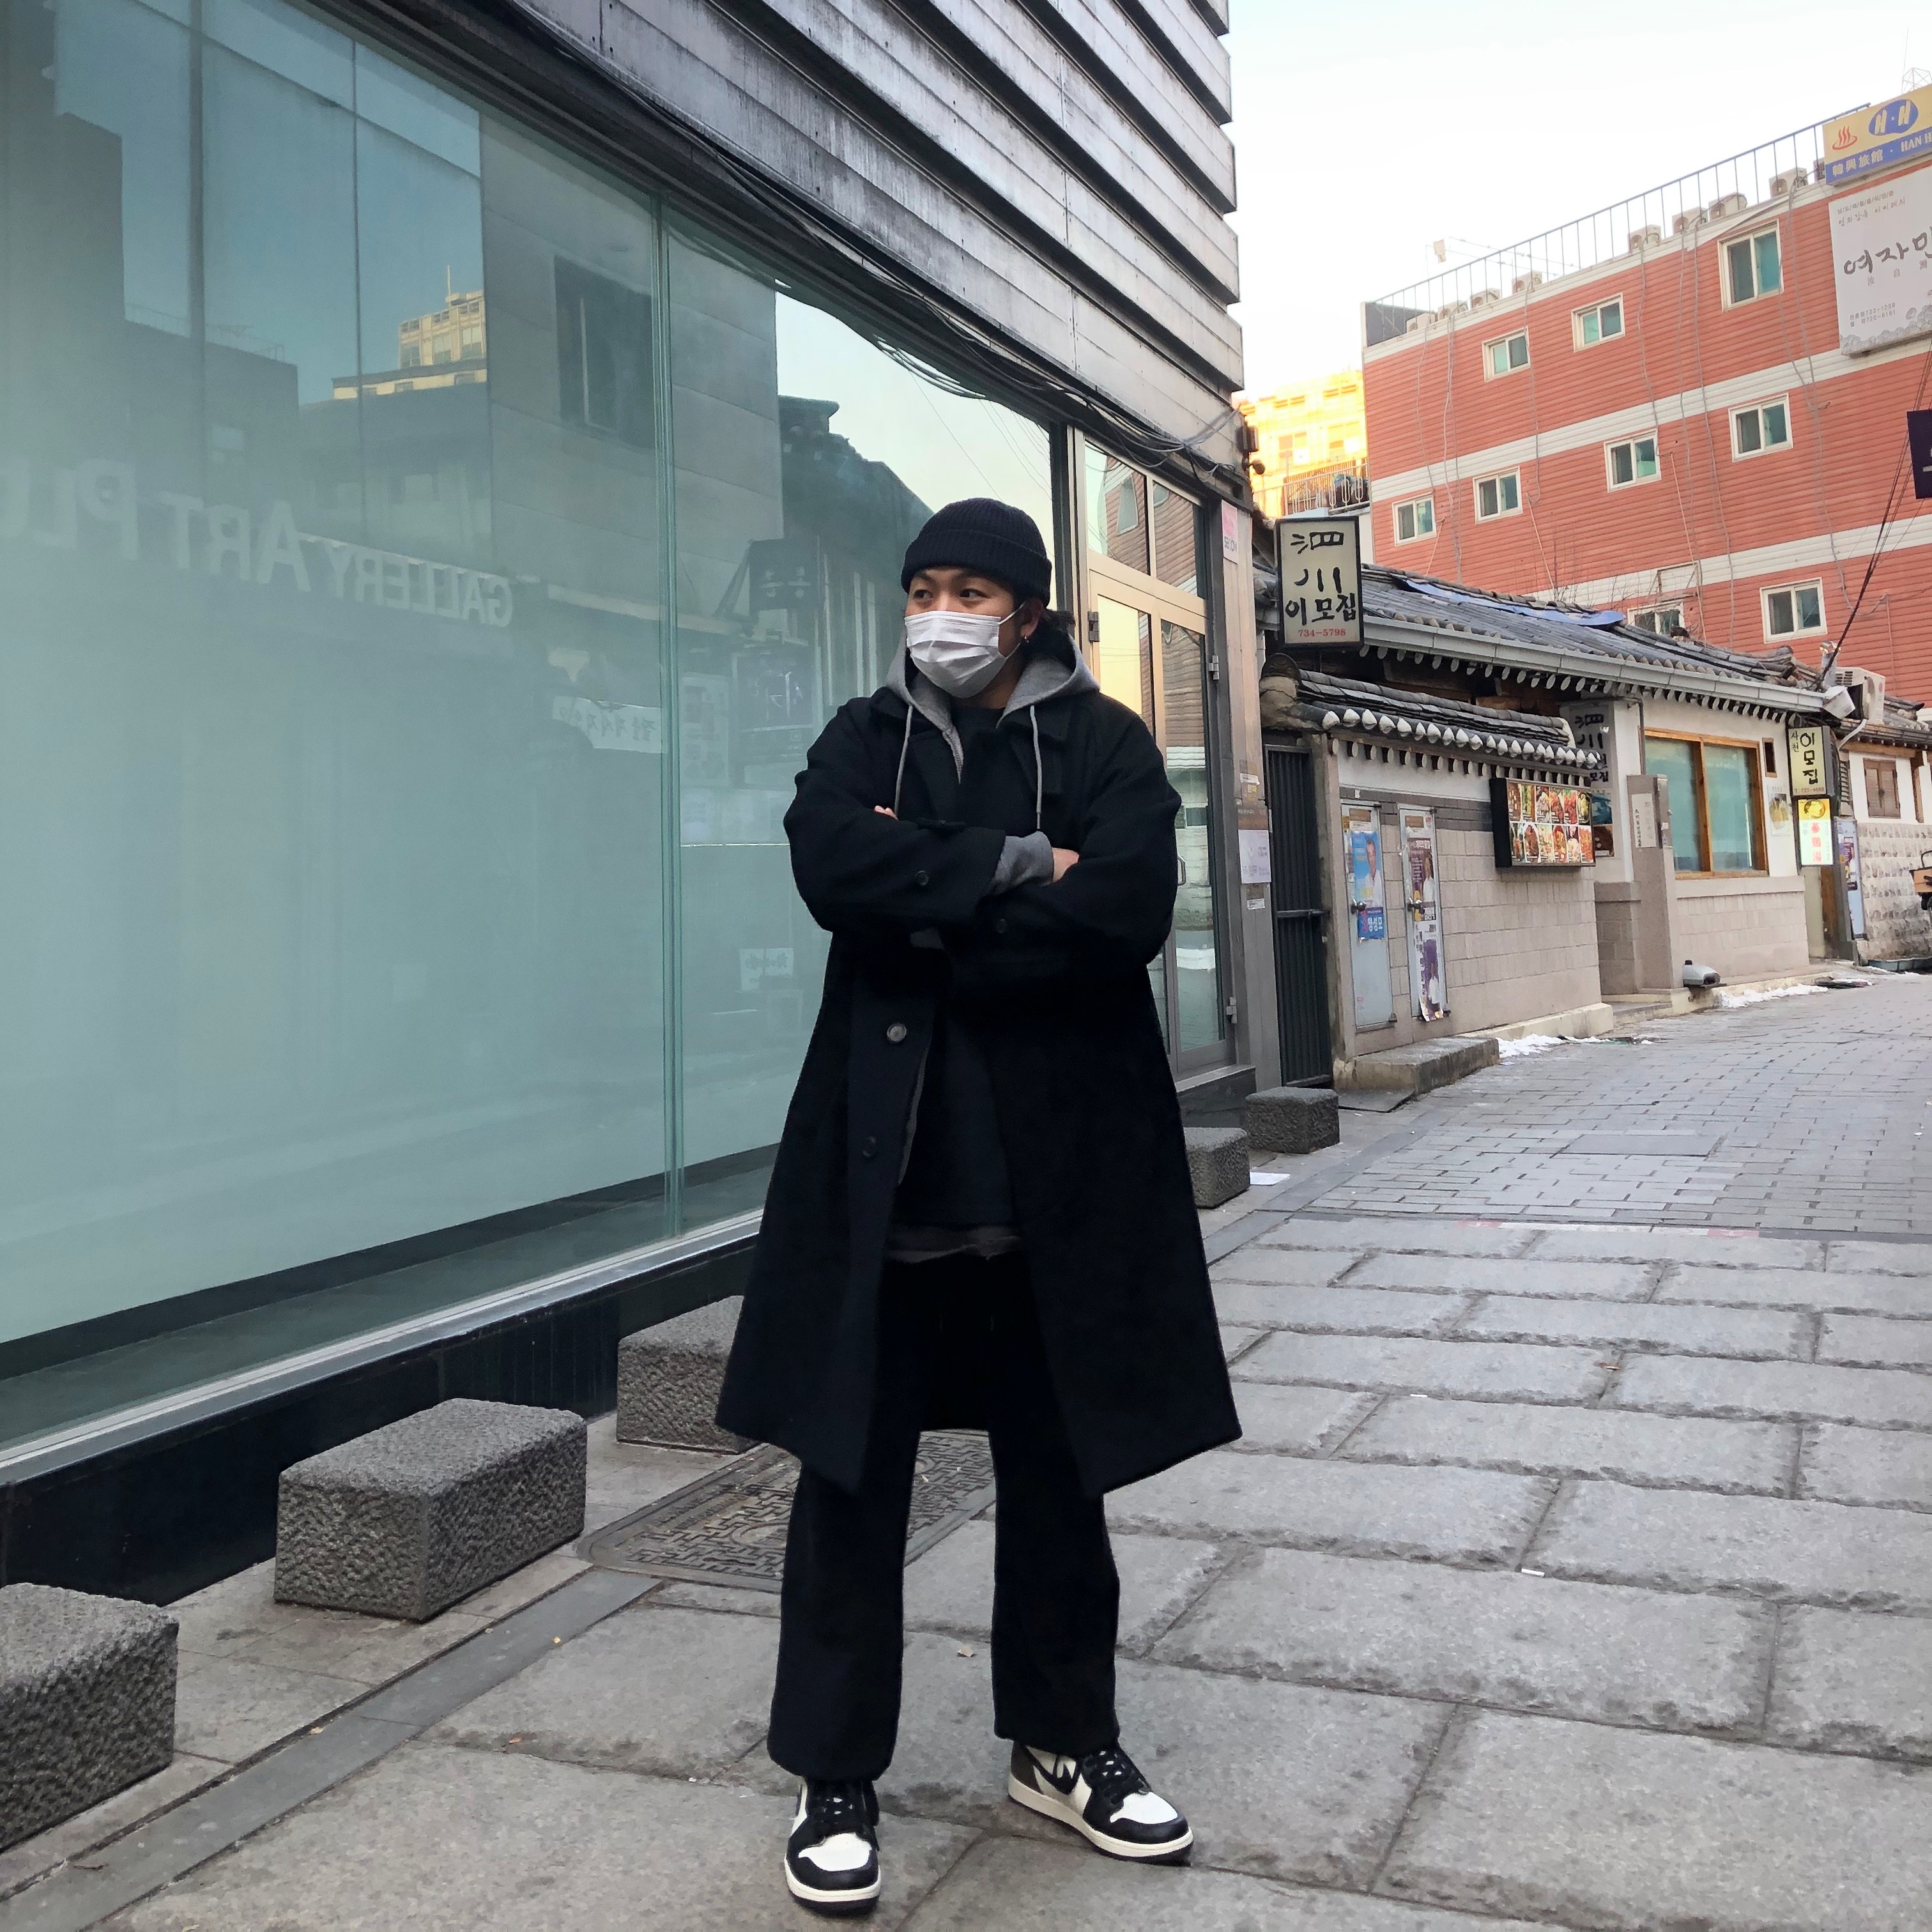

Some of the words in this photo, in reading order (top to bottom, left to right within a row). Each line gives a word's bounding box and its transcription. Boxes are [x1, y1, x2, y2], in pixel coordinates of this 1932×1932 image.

[1901, 135, 1922, 152] HAN
[1285, 592, 1356, 626] 이모집
[1298, 627, 1346, 638] 734-5798
[1800, 732, 1818, 785] 이모집
